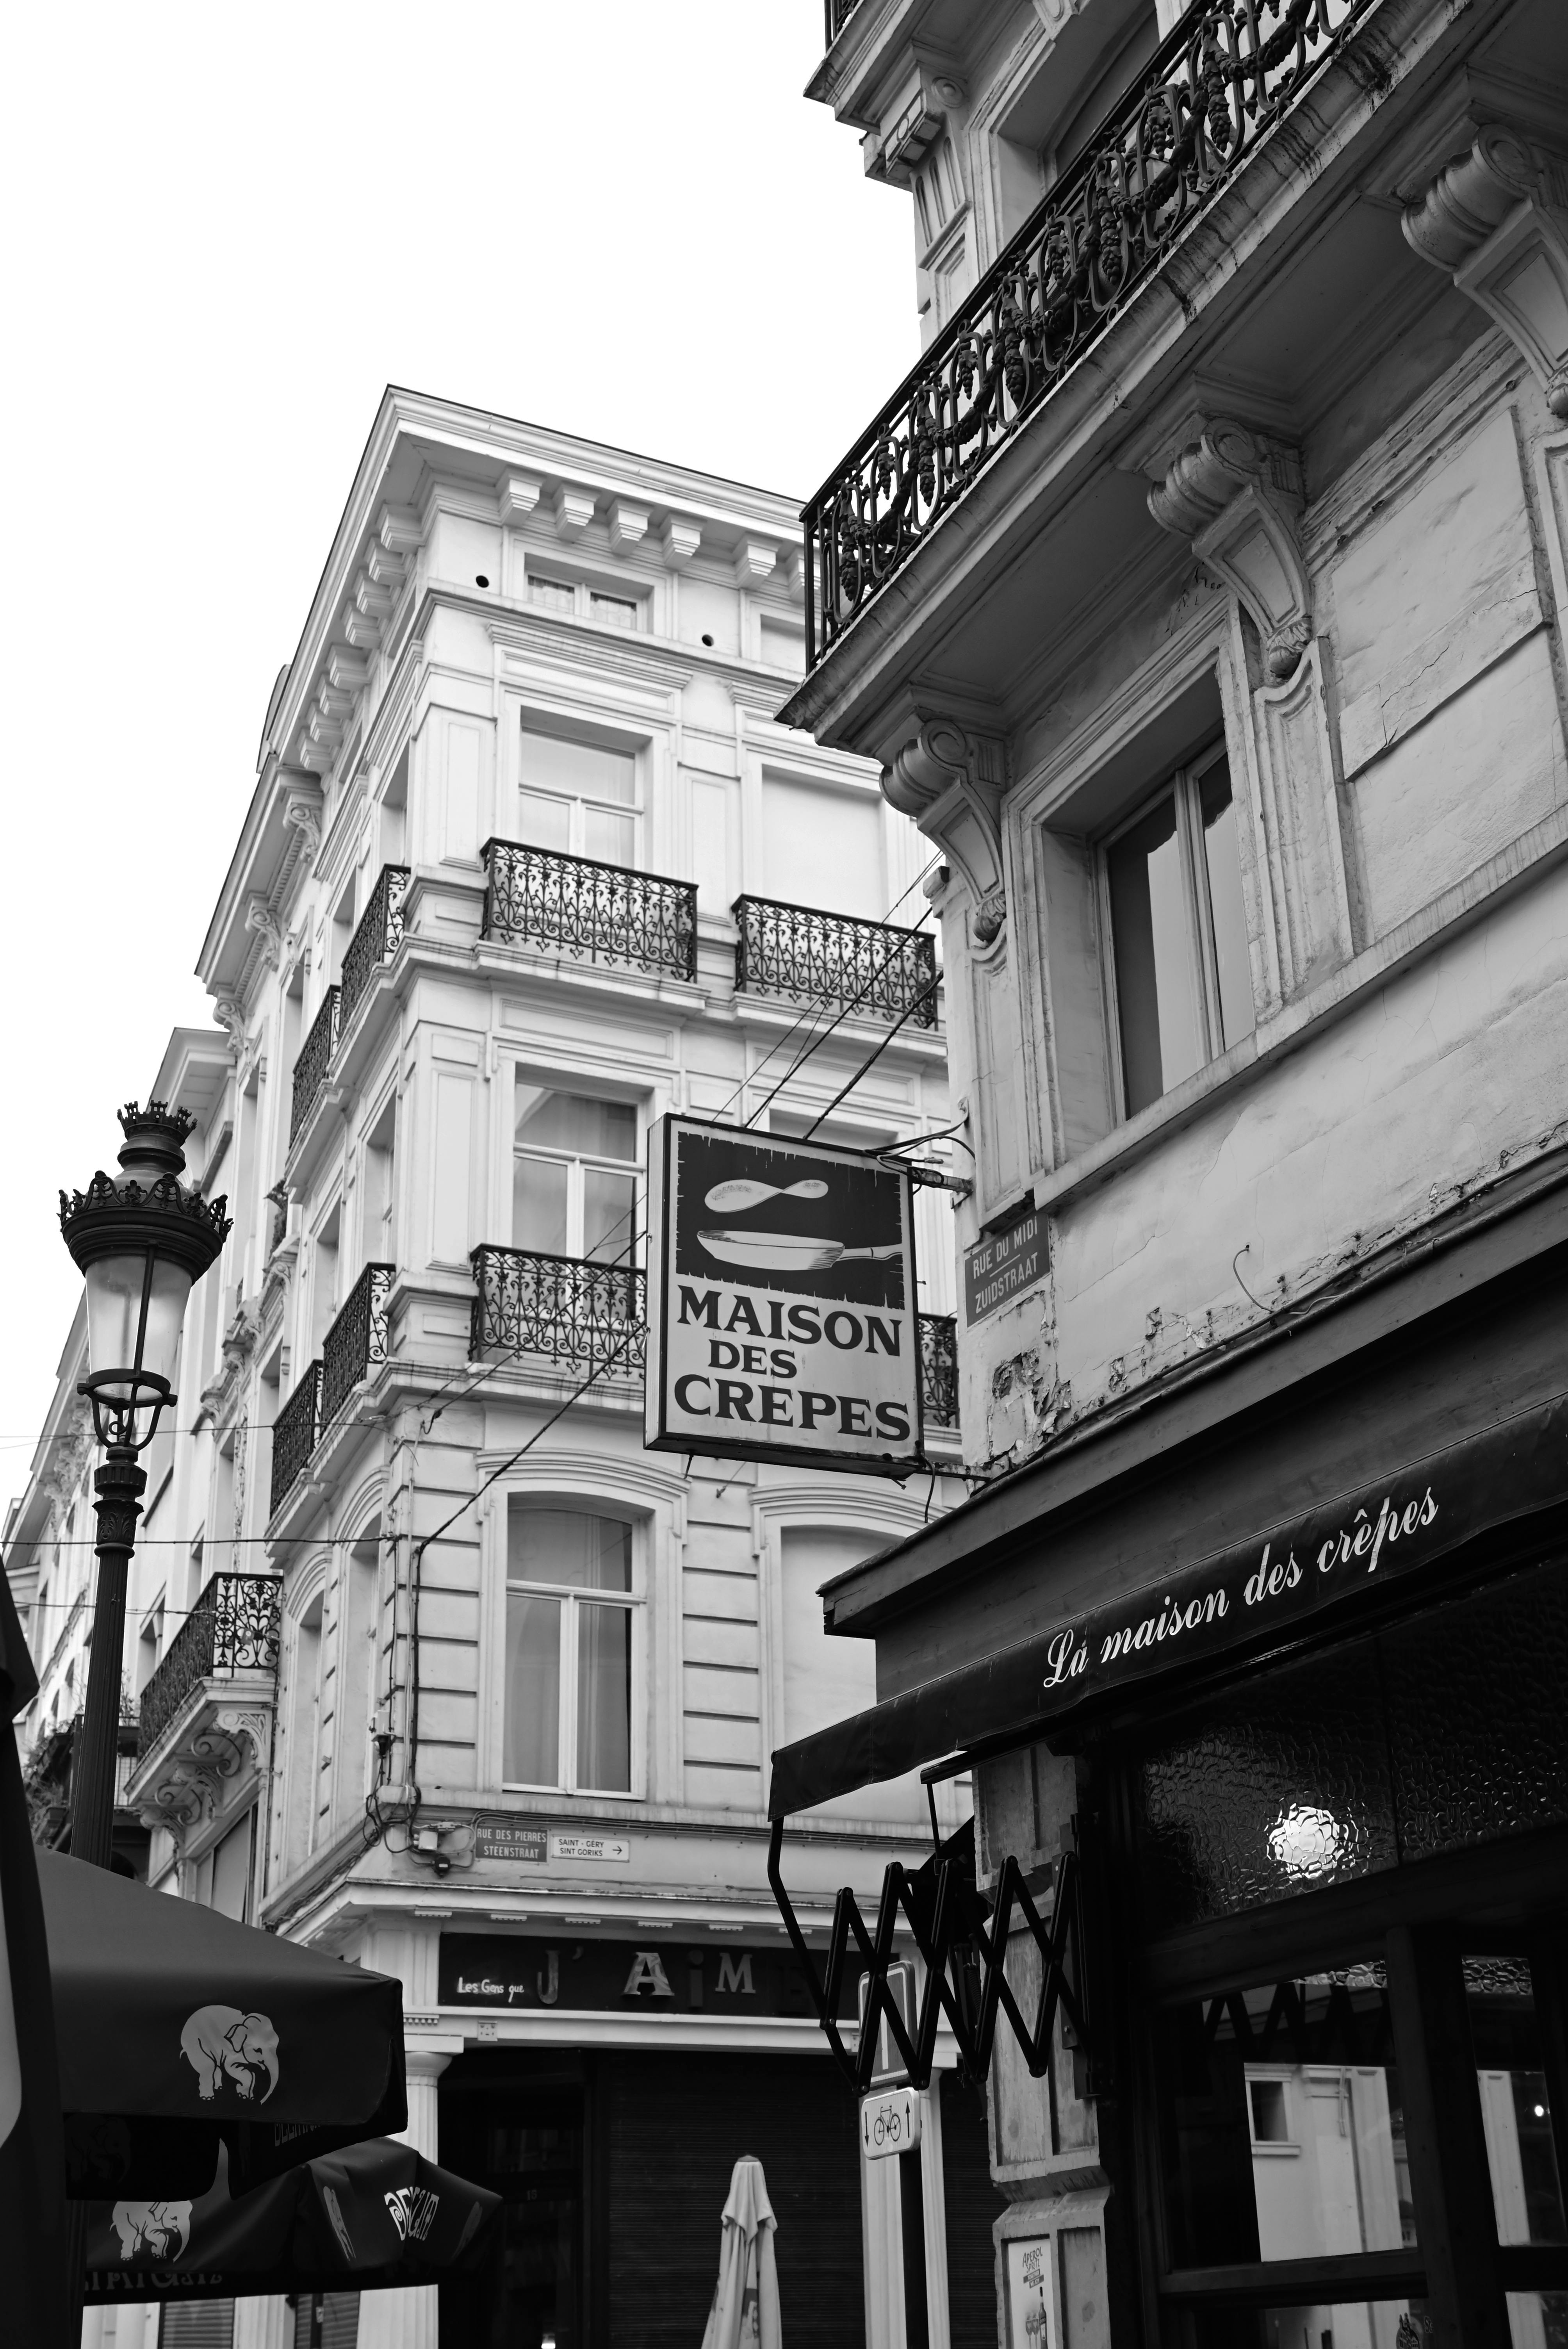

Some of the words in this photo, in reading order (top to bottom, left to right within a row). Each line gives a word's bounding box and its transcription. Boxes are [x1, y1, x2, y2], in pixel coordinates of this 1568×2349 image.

[973, 1249, 992, 1279] RUE
[996, 1237, 1009, 1262] DU
[1014, 1216, 1038, 1249] MIDI
[975, 1252, 1038, 1314] ZUIDSTRAAT
[677, 1285, 902, 1357] MAISON
[709, 1339, 797, 1378] DES
[674, 1374, 910, 1442] CREPES
[1043, 1629, 1089, 1688] La
[1100, 1589, 1229, 1663] maison
[1244, 1543, 1303, 1606] des
[1317, 1487, 1439, 1572] crêpes
[477, 1829, 492, 1839] RUE
[496, 1830, 511, 1840] DES
[515, 1831, 546, 1843] PIERRES
[484, 1846, 539, 1859] STEENSTRAAT
[457, 1977, 478, 1993] Les
[481, 1979, 504, 1994] Gens
[508, 1985, 524, 2003] que
[1023, 2246, 1043, 2267] APEROL
[1026, 2259, 1040, 2273] SPRITZ
